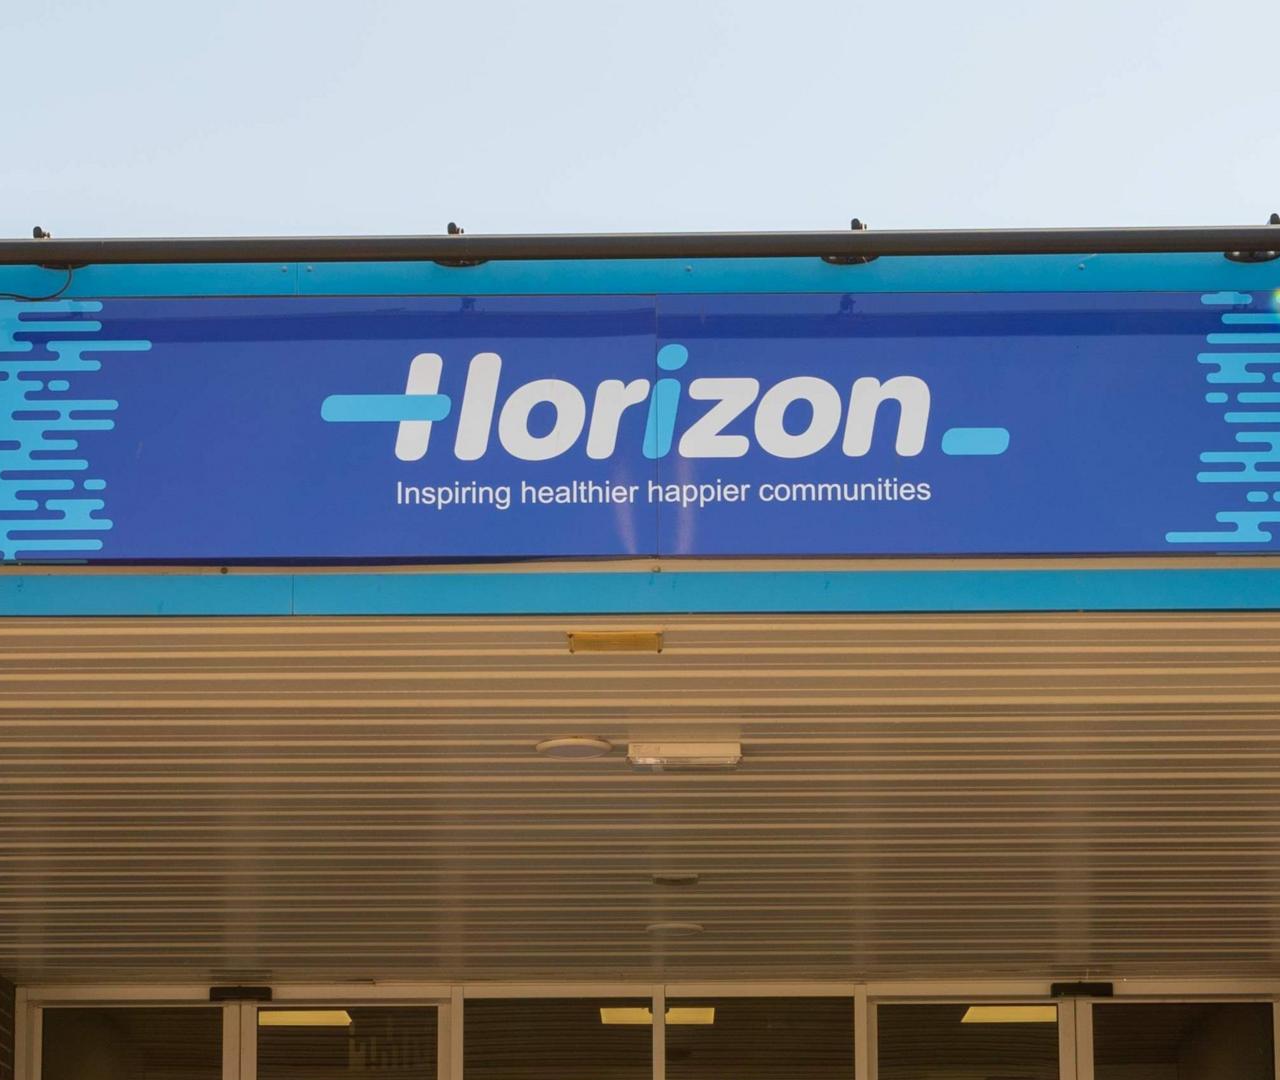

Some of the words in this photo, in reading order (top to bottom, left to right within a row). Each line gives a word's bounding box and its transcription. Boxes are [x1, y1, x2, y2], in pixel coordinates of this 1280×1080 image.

[321, 343, 932, 461] Horizon
[396, 481, 511, 510] Inspiring
[521, 480, 639, 505] healthier
[647, 479, 750, 509] happier
[758, 478, 932, 504] communities
